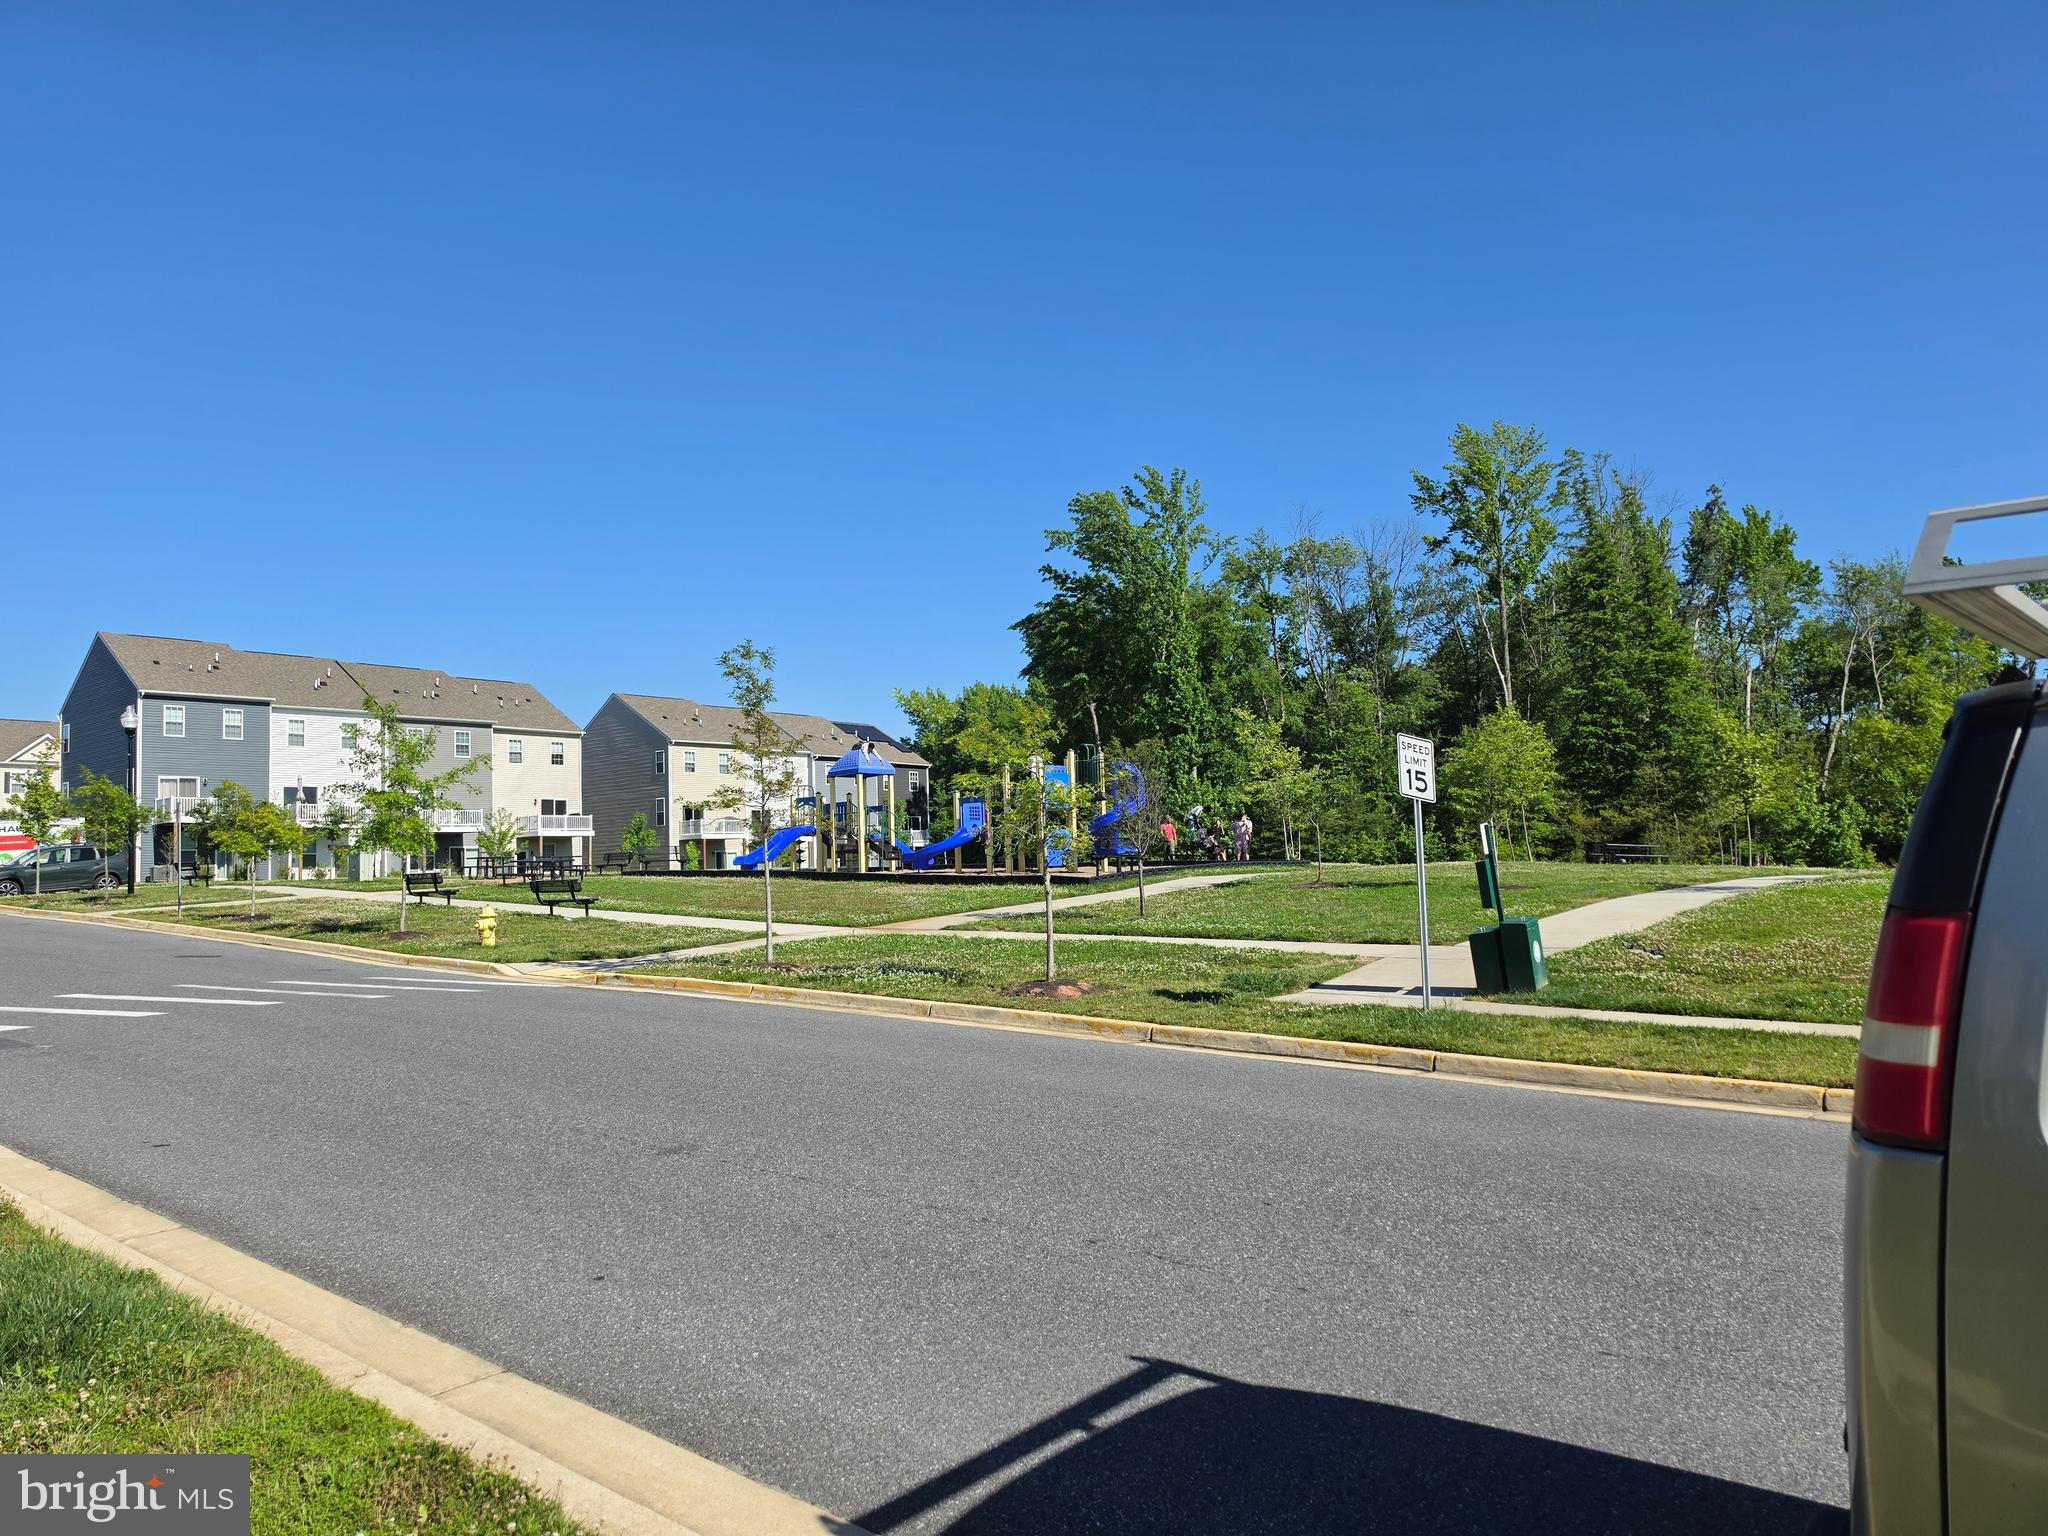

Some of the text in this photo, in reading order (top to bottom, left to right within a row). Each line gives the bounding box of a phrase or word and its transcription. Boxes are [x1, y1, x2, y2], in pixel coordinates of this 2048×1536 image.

[1401, 741, 1430, 755] SPEED
[1404, 754, 1427, 768] LIMIT
[1406, 768, 1428, 793] 15
